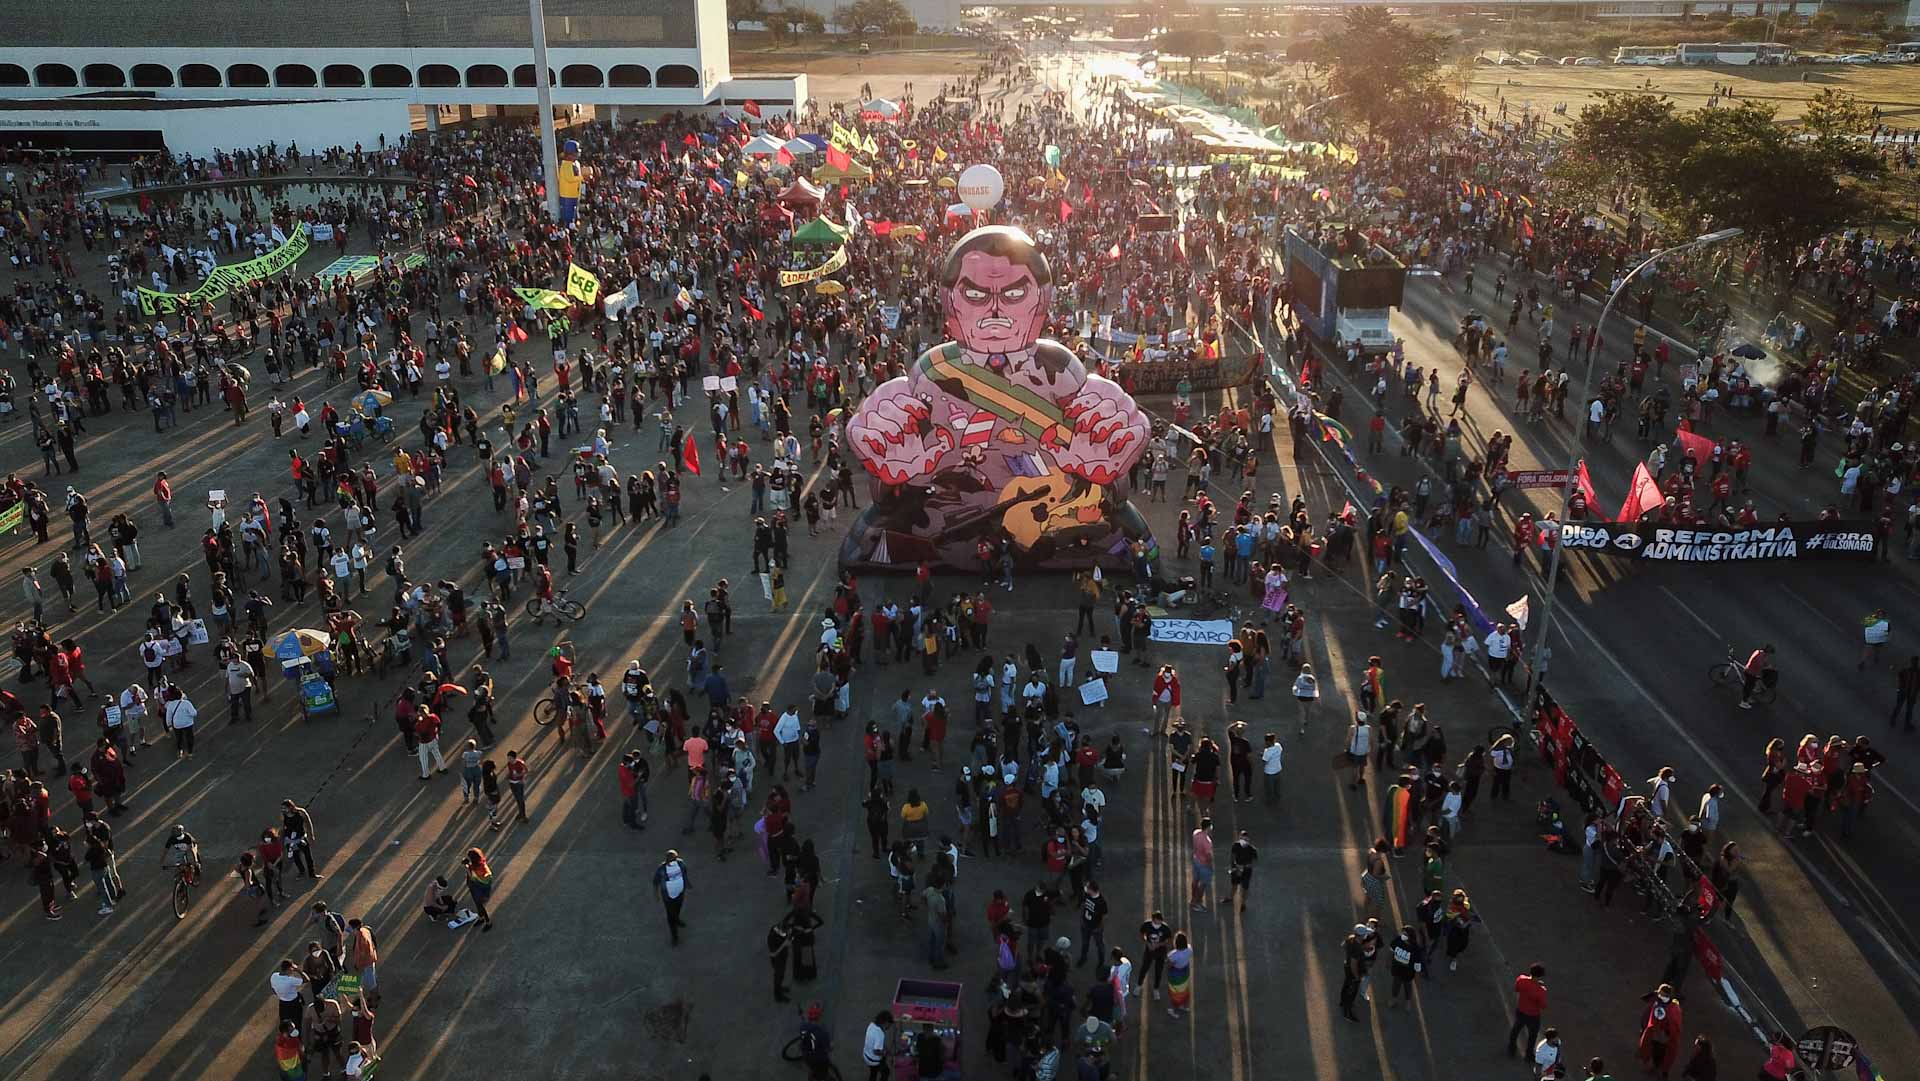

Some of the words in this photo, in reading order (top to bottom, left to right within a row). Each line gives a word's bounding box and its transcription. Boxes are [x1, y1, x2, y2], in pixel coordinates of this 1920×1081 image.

[1561, 524, 1610, 540] DIGA
[1655, 526, 1795, 543] REFORMA
[1641, 541, 1797, 561] ADMINISTRATIVA
[1822, 540, 1874, 552] BOLSONARO
[1152, 620, 1203, 630] ORA
